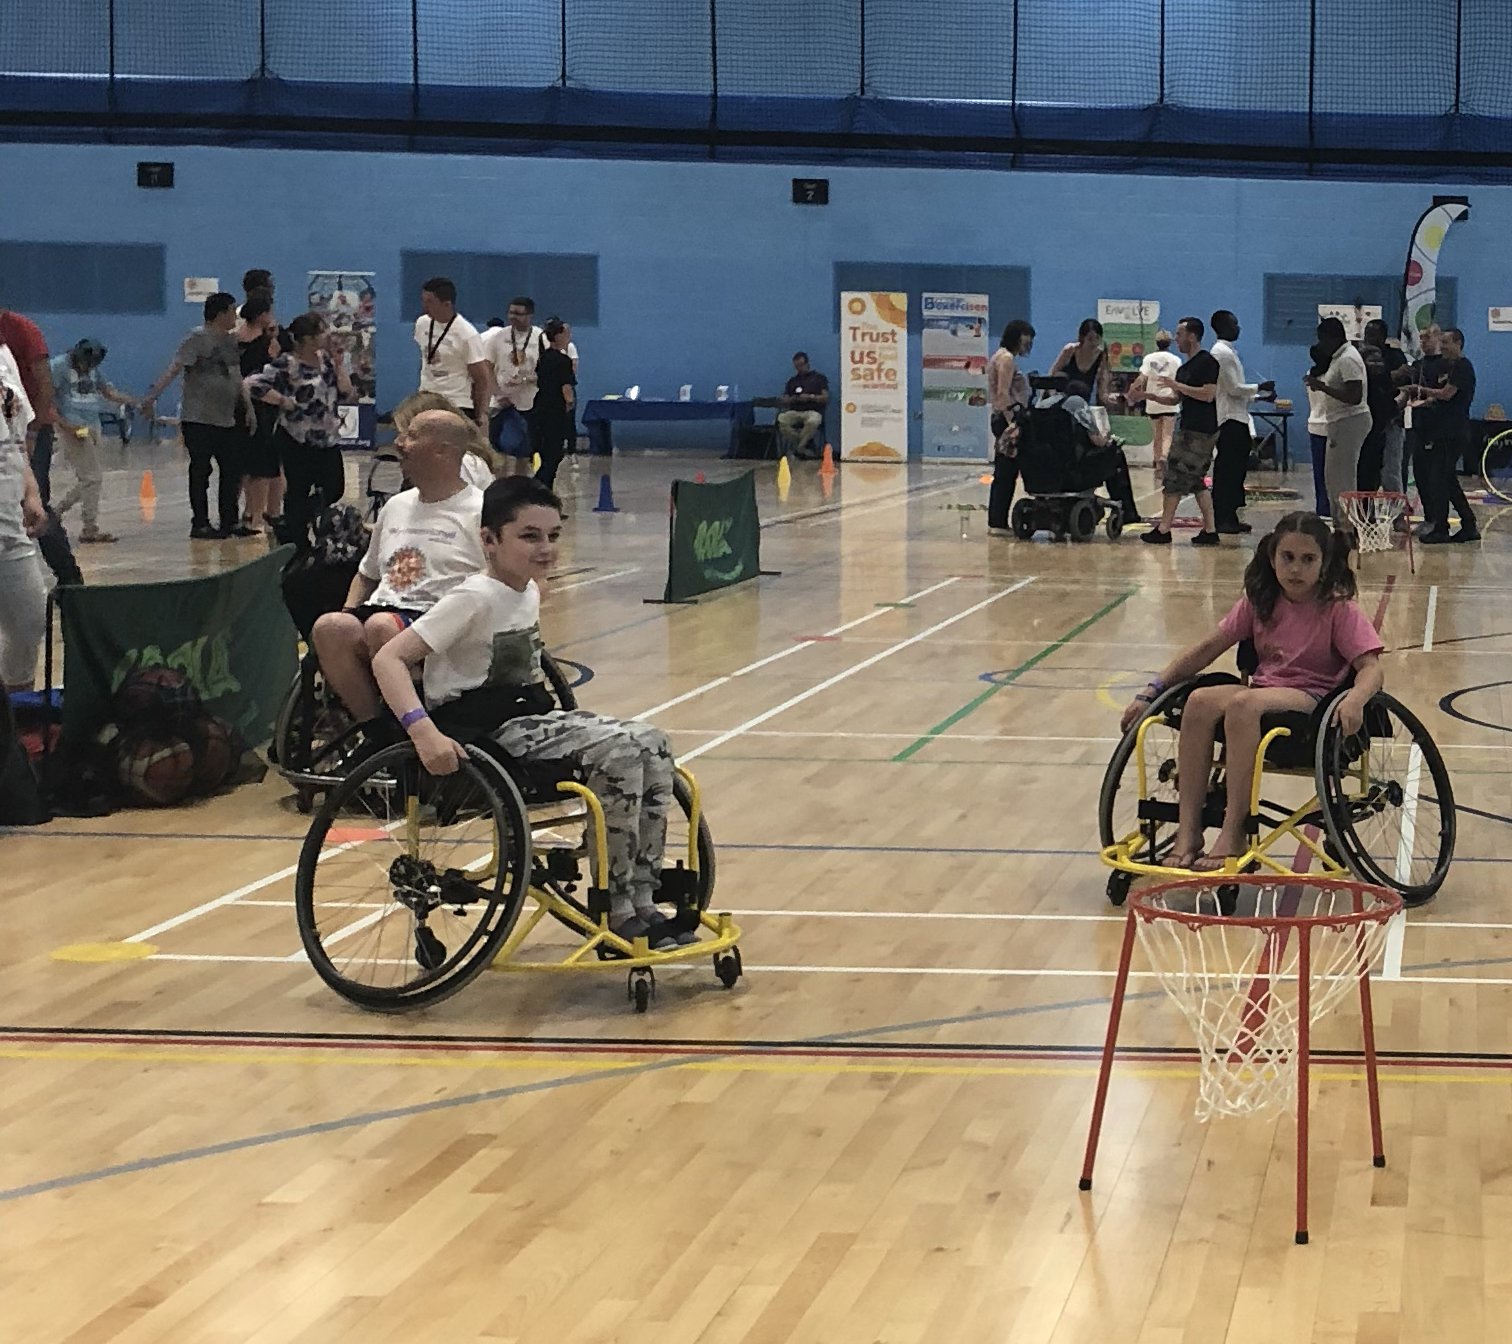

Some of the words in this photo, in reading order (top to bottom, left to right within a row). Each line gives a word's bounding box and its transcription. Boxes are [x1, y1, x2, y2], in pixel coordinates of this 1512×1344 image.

[849, 326, 898, 344] Trust
[850, 348, 878, 365] us
[850, 362, 898, 382] safe
